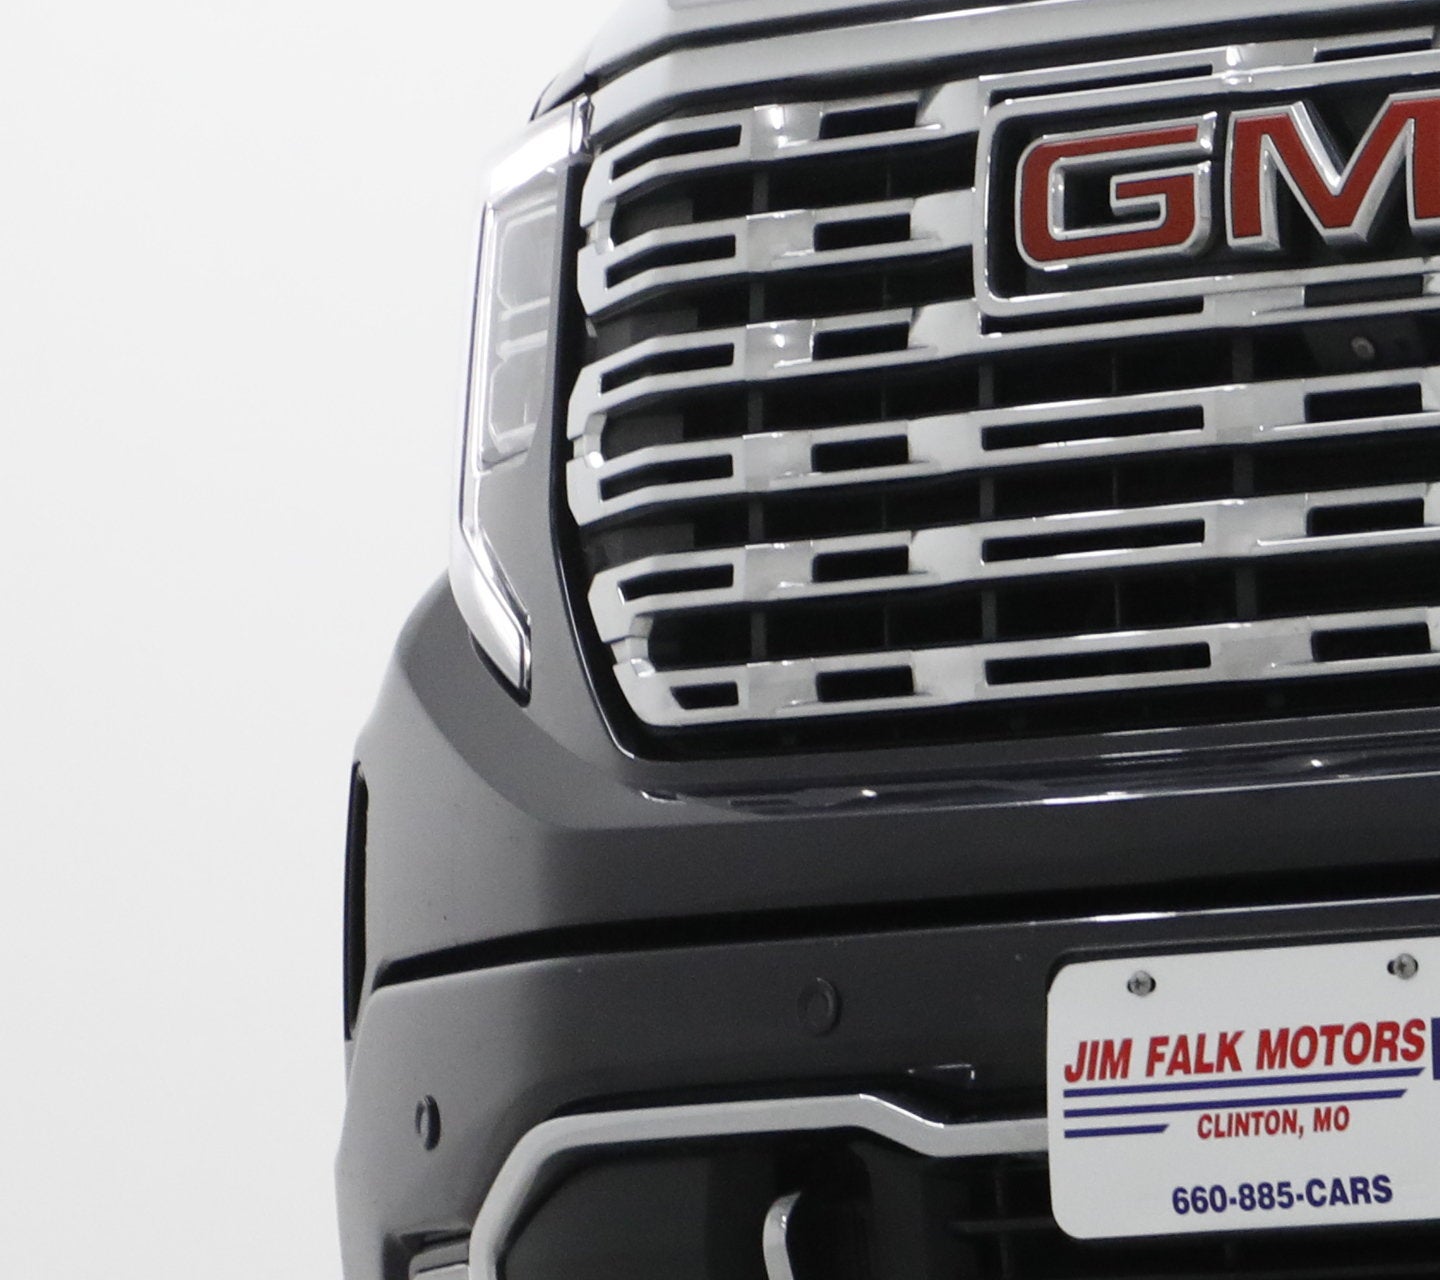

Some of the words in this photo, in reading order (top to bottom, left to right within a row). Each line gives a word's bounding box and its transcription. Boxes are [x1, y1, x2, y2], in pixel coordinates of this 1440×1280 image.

[1064, 1038, 1132, 1083] JIM
[1145, 1031, 1245, 1077] FALK
[1256, 1018, 1426, 1070] MOTORS
[1197, 1108, 1305, 1140] CLINTON,
[1313, 1105, 1350, 1132] MO
[1172, 1174, 1393, 1215] 660-885-CARS
